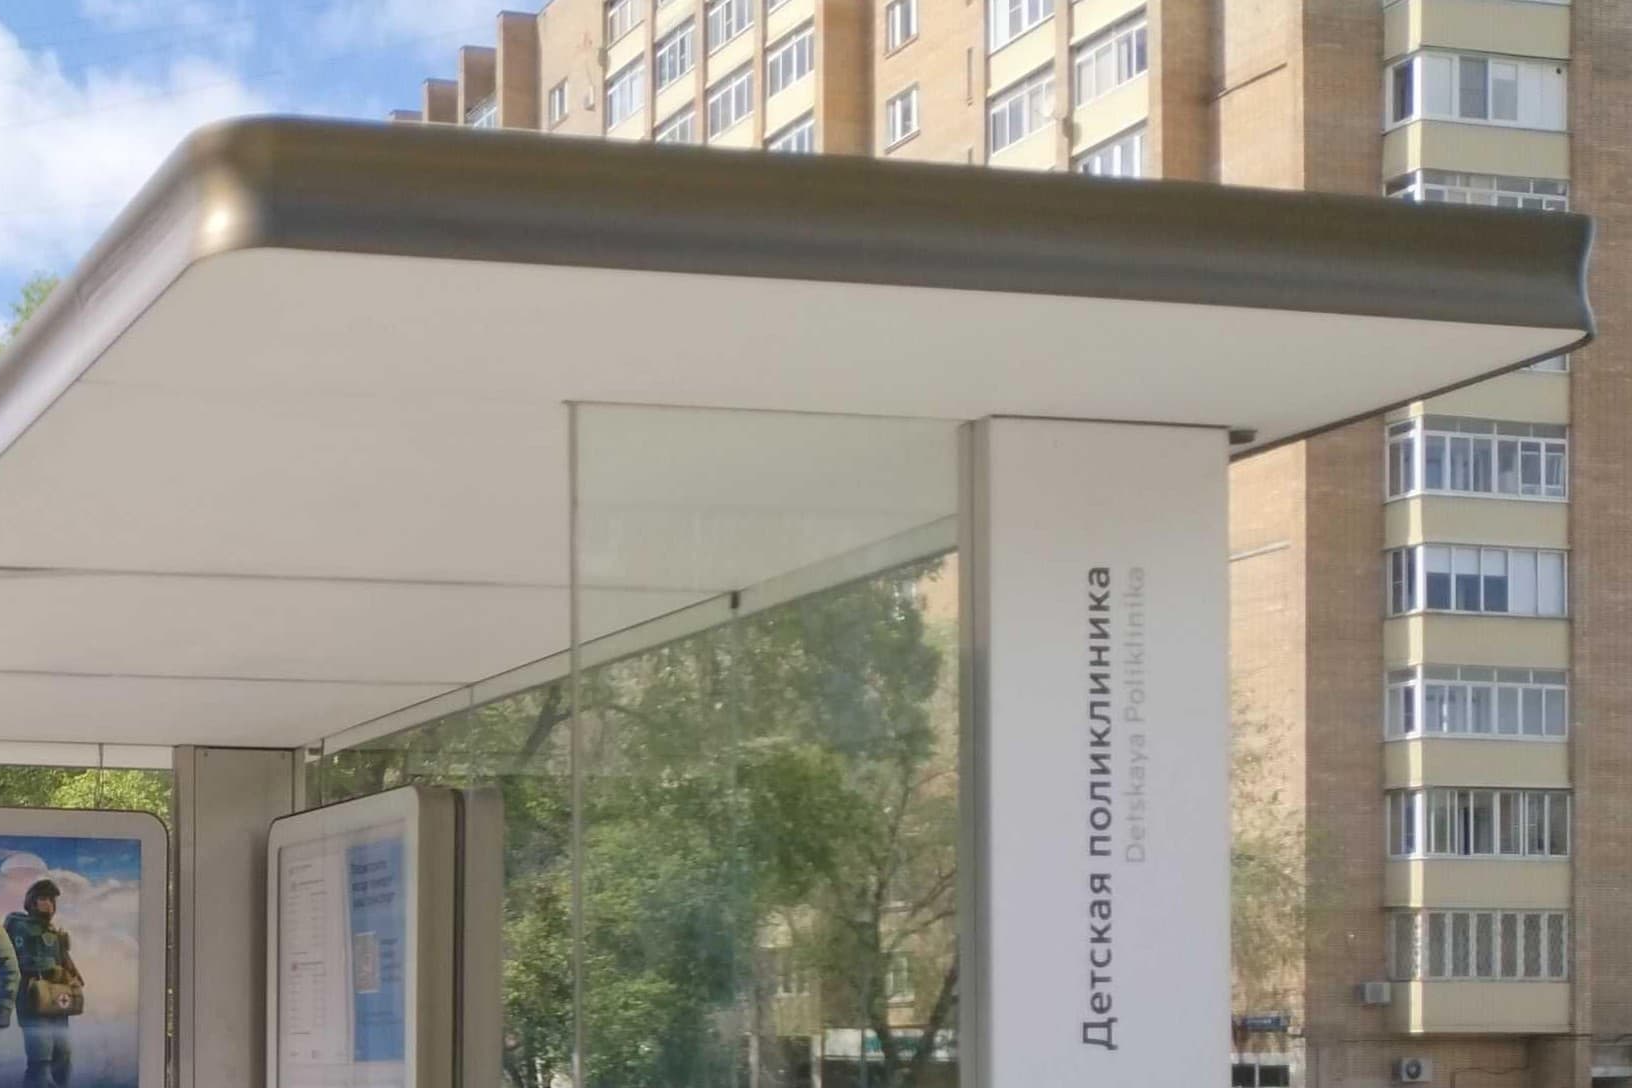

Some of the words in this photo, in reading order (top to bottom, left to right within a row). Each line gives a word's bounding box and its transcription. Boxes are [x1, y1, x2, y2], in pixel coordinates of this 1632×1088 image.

[1087, 565, 1112, 857] поликлиника
[1122, 566, 1146, 722] Poliklinika
[1122, 733, 1149, 864] Detskaya
[1081, 872, 1118, 1051] Детская
